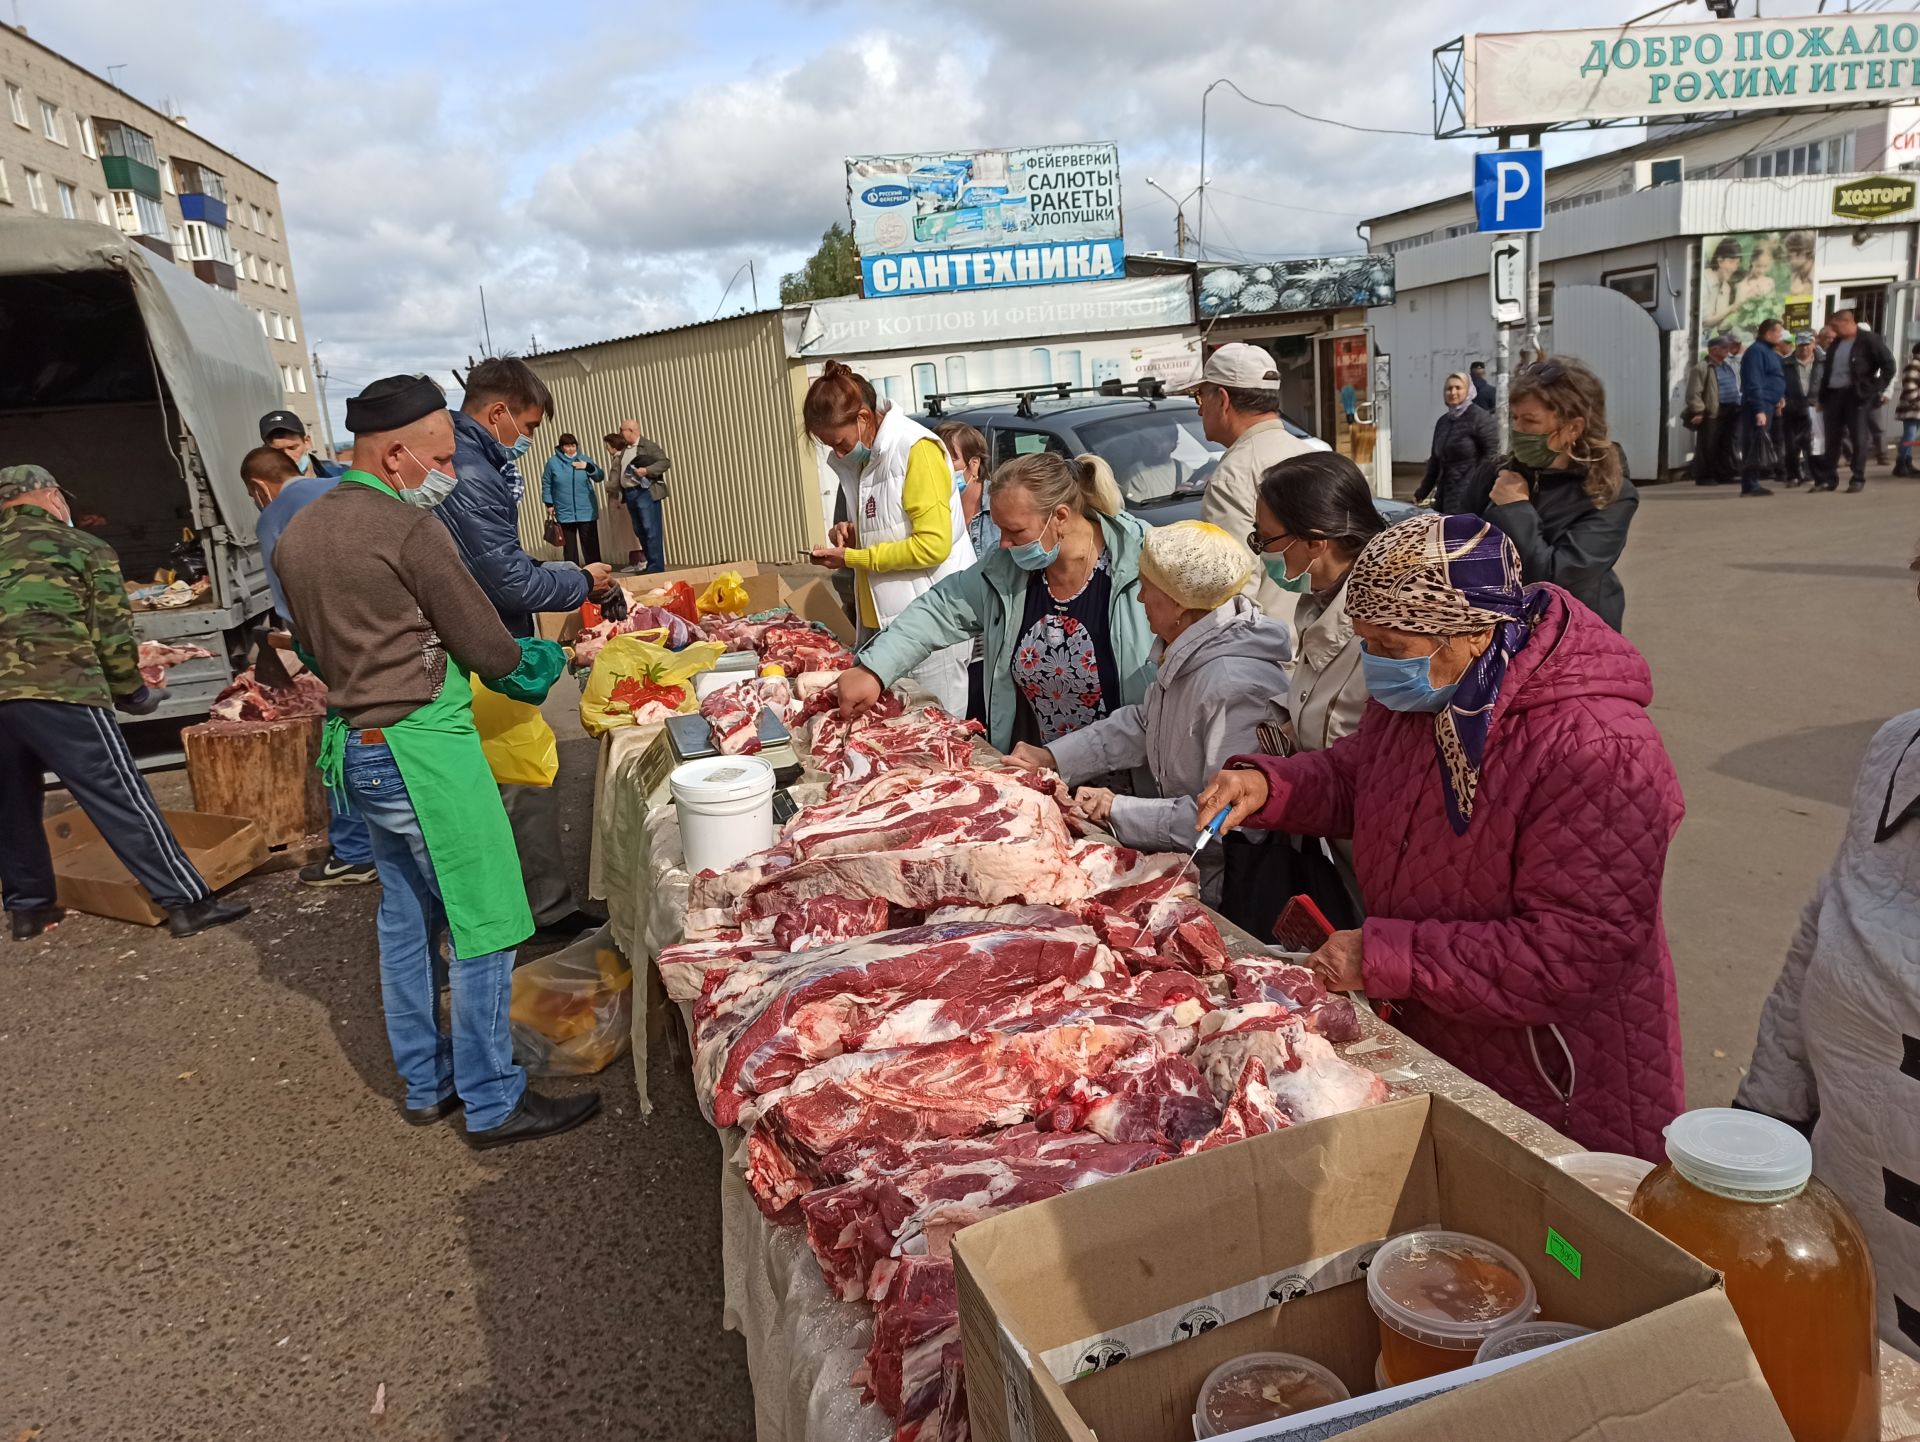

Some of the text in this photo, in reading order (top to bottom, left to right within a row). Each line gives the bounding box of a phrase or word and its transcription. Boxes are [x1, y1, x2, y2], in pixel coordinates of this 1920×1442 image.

[1580, 22, 1919, 78] ДОБРО ПОЖАЛО
[1648, 65, 1798, 103] РӘХИМ
[1026, 153, 1111, 169] ФЕЙЕРВЕРКИ
[1028, 170, 1112, 190] САЛЮТЫ
[1496, 162, 1530, 222] P
[1030, 189, 1112, 212] РАКЕТЫ
[1840, 186, 1912, 206] ХОЗТОРГ
[1031, 209, 1114, 226] ХЛОПУШКИ
[872, 244, 1114, 292] САНТЕХНИКА
[877, 310, 975, 336] КОТЛОВ
[983, 308, 1000, 326] И
[1005, 297, 1168, 324] ФЕЙЕРВЕРКОВ
